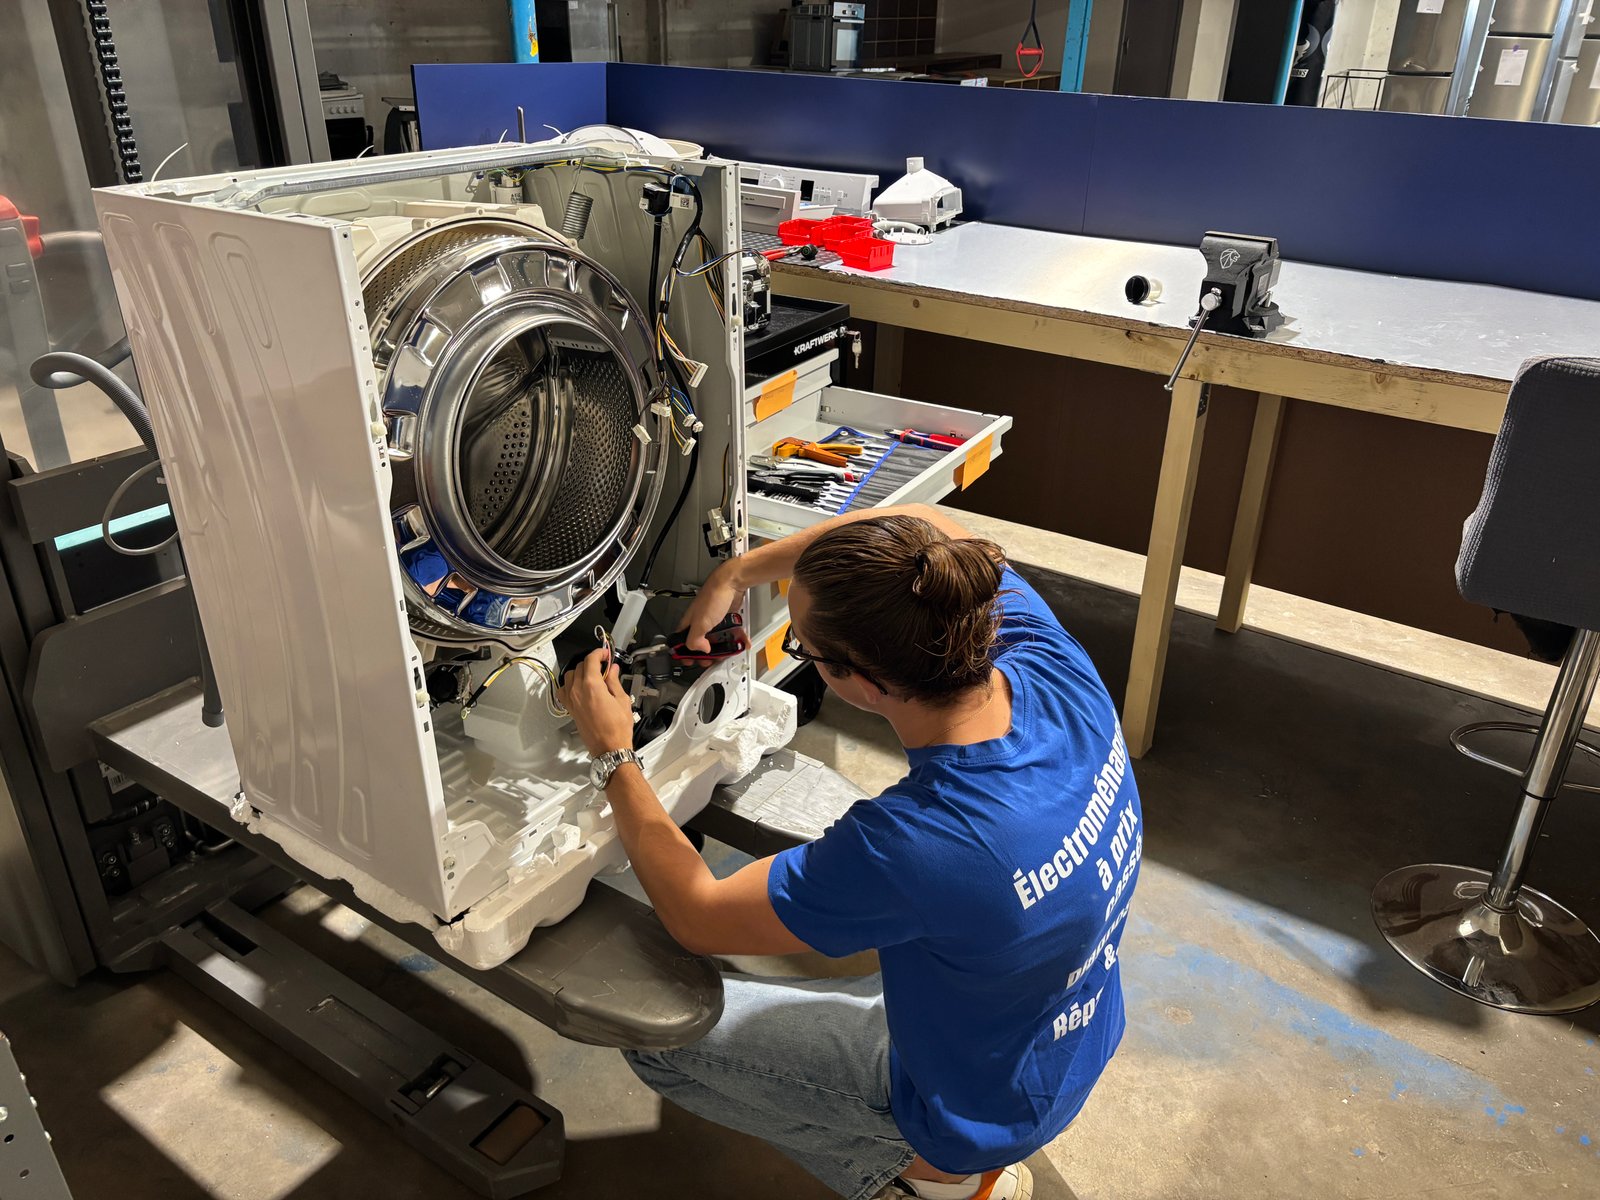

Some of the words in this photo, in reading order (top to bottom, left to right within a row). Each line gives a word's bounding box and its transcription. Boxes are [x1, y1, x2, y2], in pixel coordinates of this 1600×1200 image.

[794, 329, 838, 355] KRAFTWERK
[1096, 857, 1113, 891] à
[1110, 799, 1138, 871] prix
[1104, 944, 1117, 970] &
